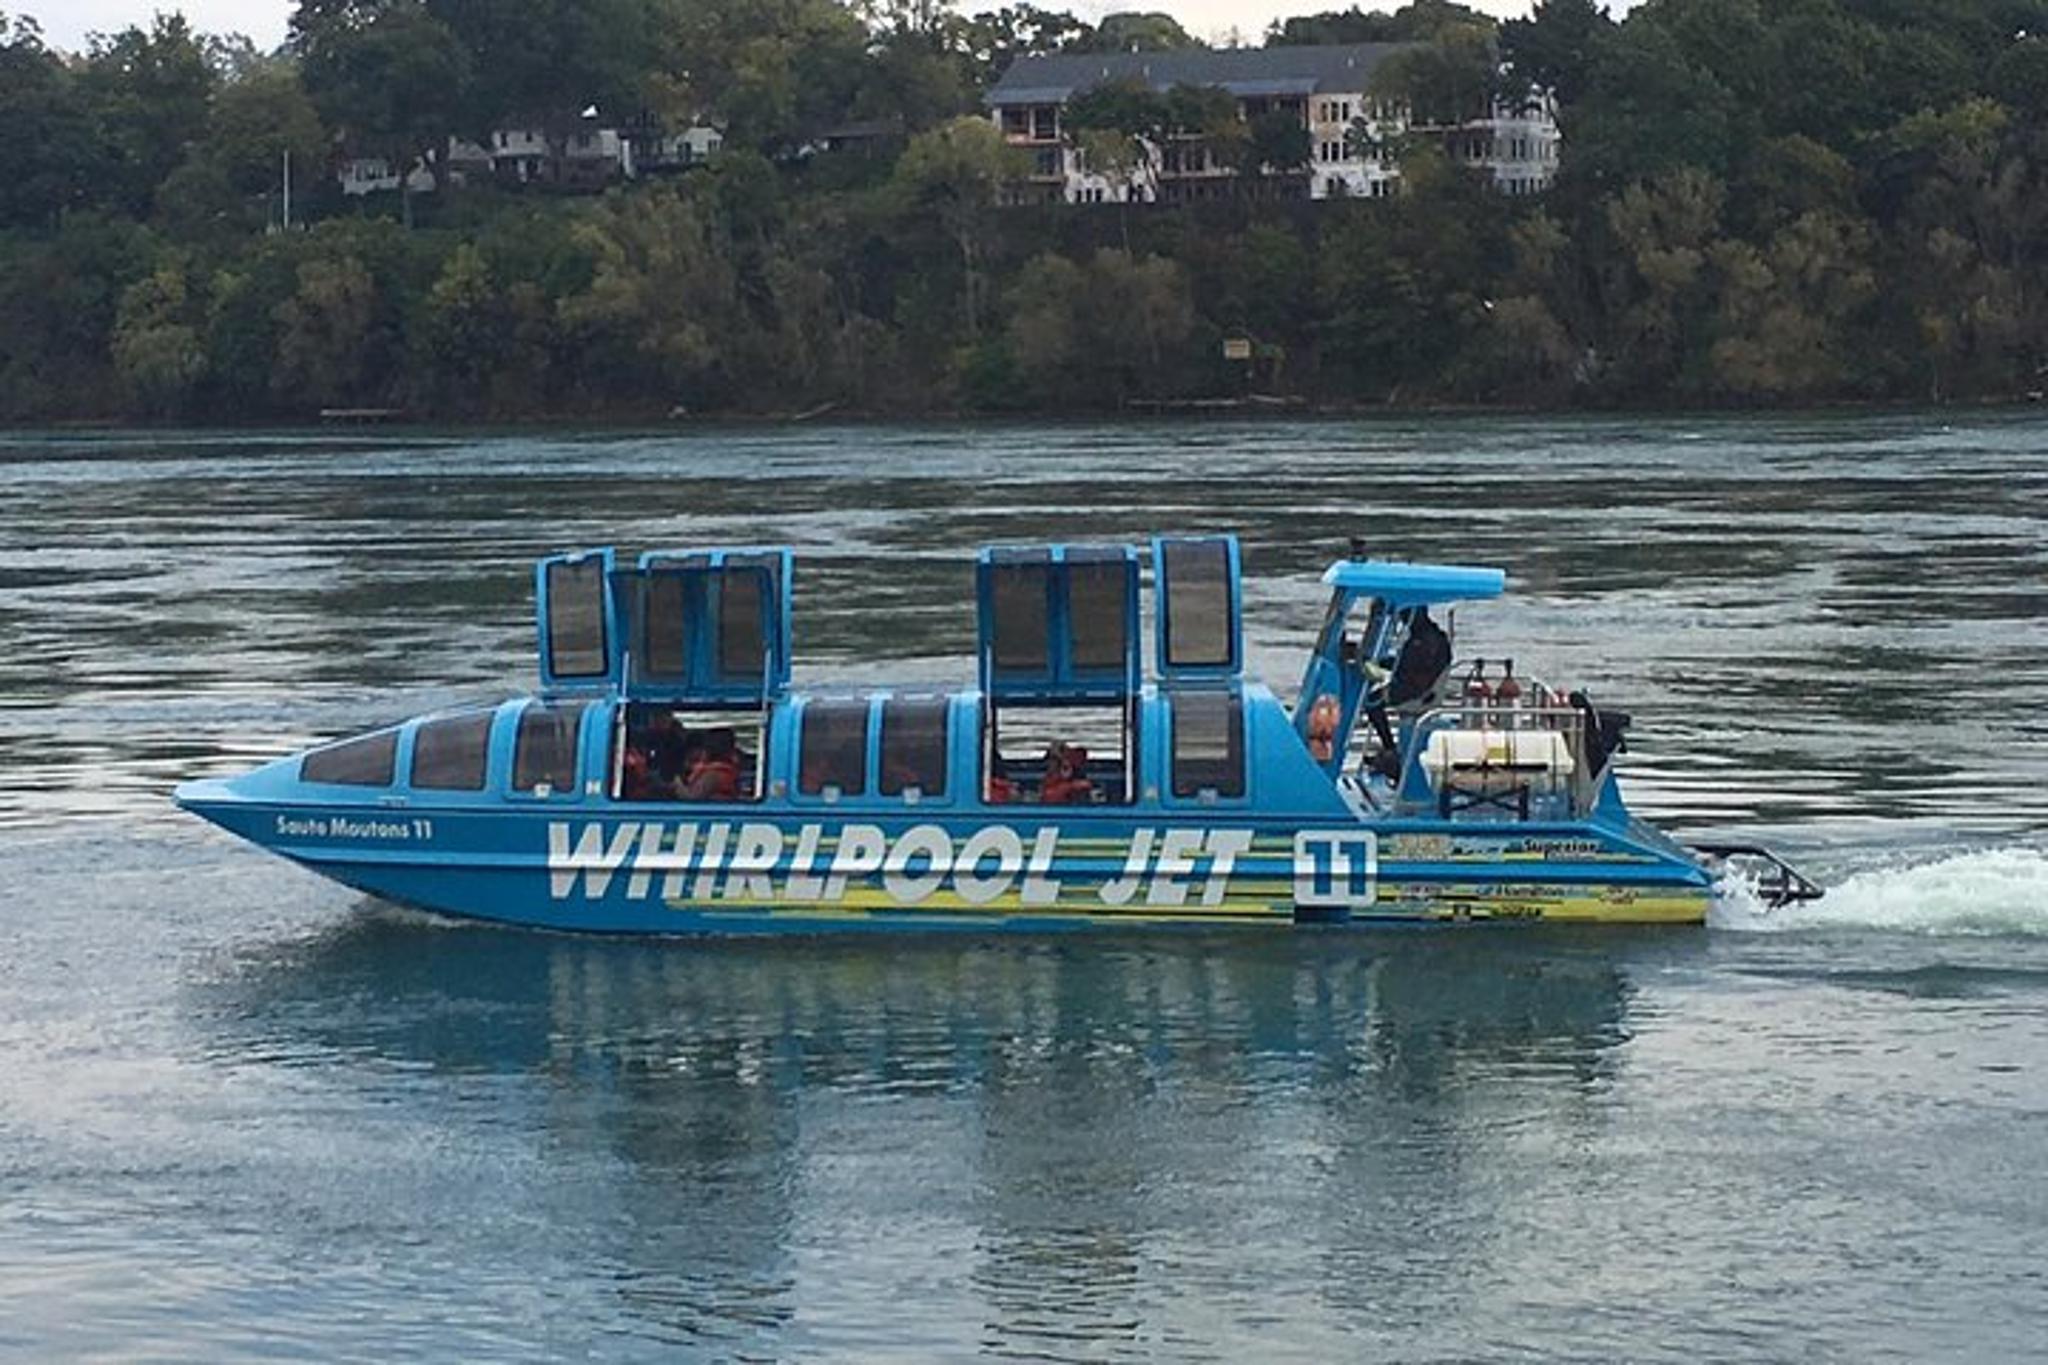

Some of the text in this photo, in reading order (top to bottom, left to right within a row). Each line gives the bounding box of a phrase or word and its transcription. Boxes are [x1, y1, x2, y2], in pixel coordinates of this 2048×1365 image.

[330, 817, 409, 838] Moutons
[412, 819, 433, 839] 11
[547, 822, 1253, 906] WHIRLPOOL JET
[1305, 840, 1368, 897] 11
